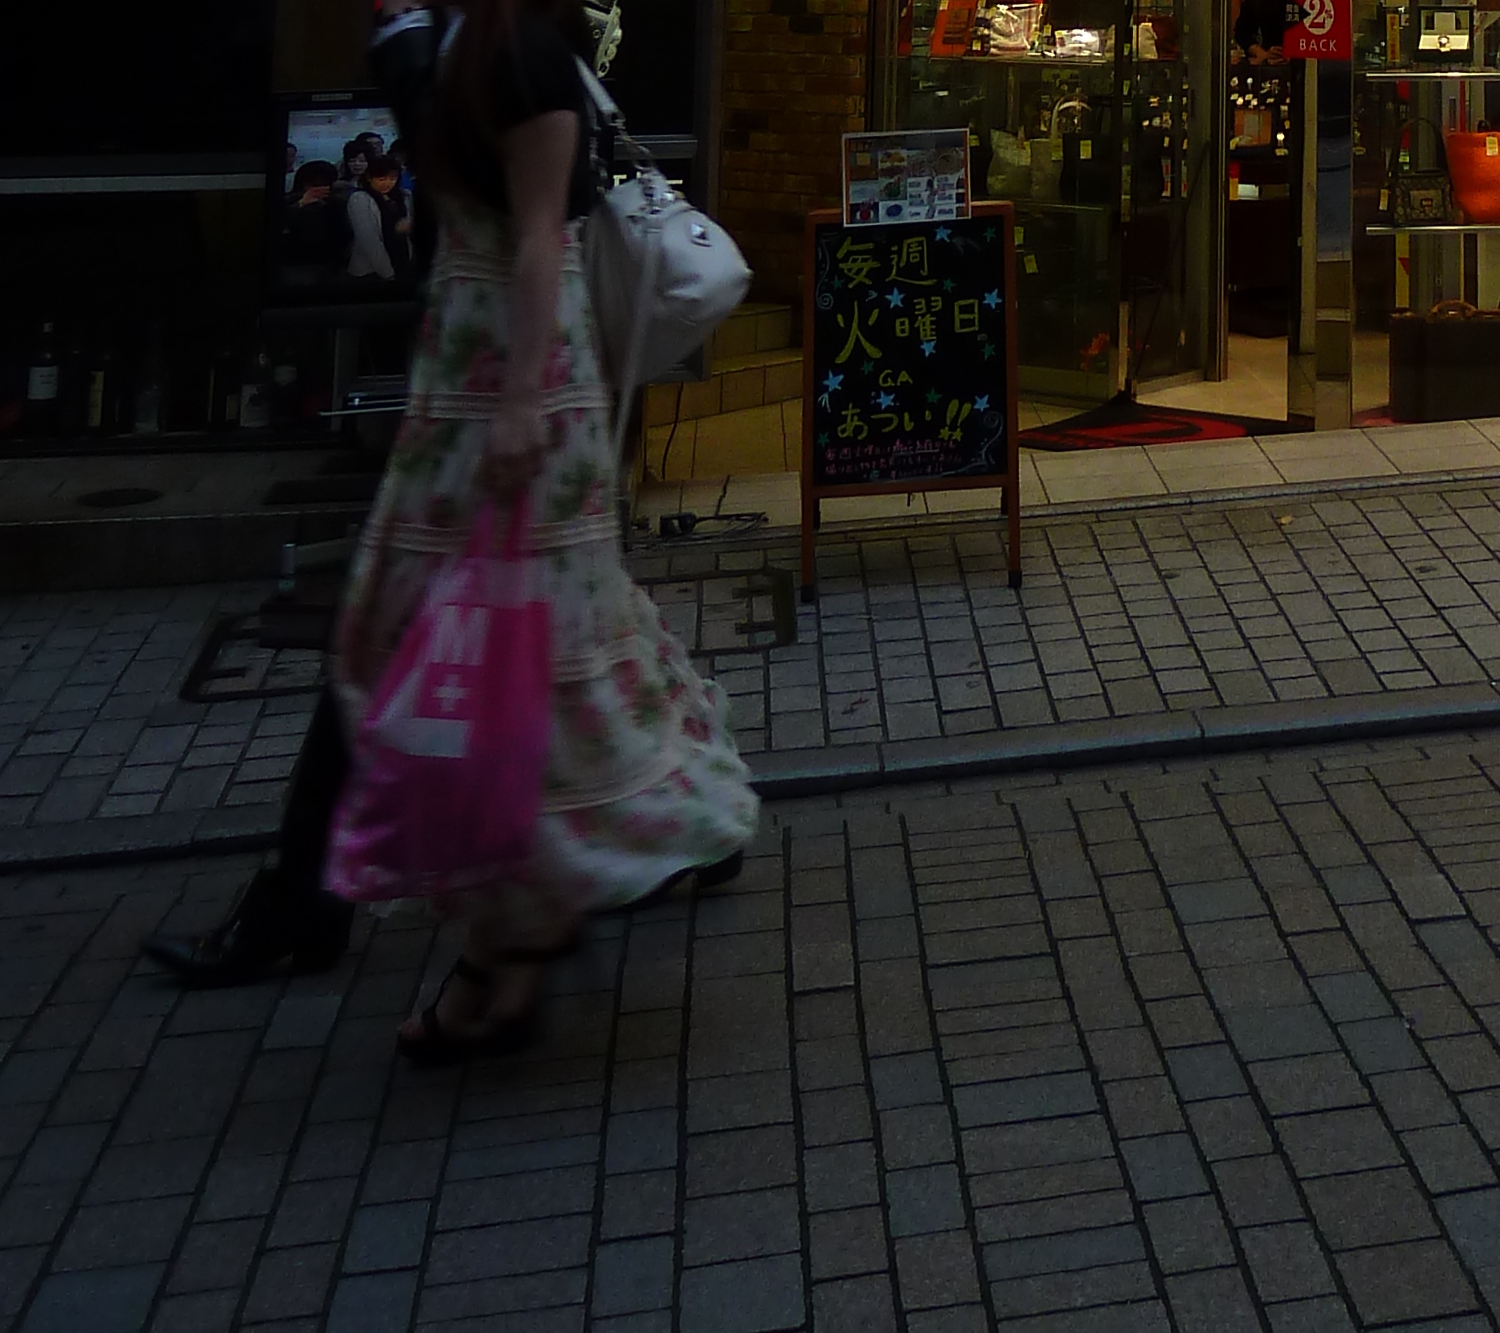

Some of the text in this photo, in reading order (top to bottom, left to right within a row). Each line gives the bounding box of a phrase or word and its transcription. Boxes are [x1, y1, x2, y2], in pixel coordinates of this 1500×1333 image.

[1300, 38, 1337, 52] BACK
[836, 236, 938, 289] 毎週
[835, 296, 981, 364] 火曜日
